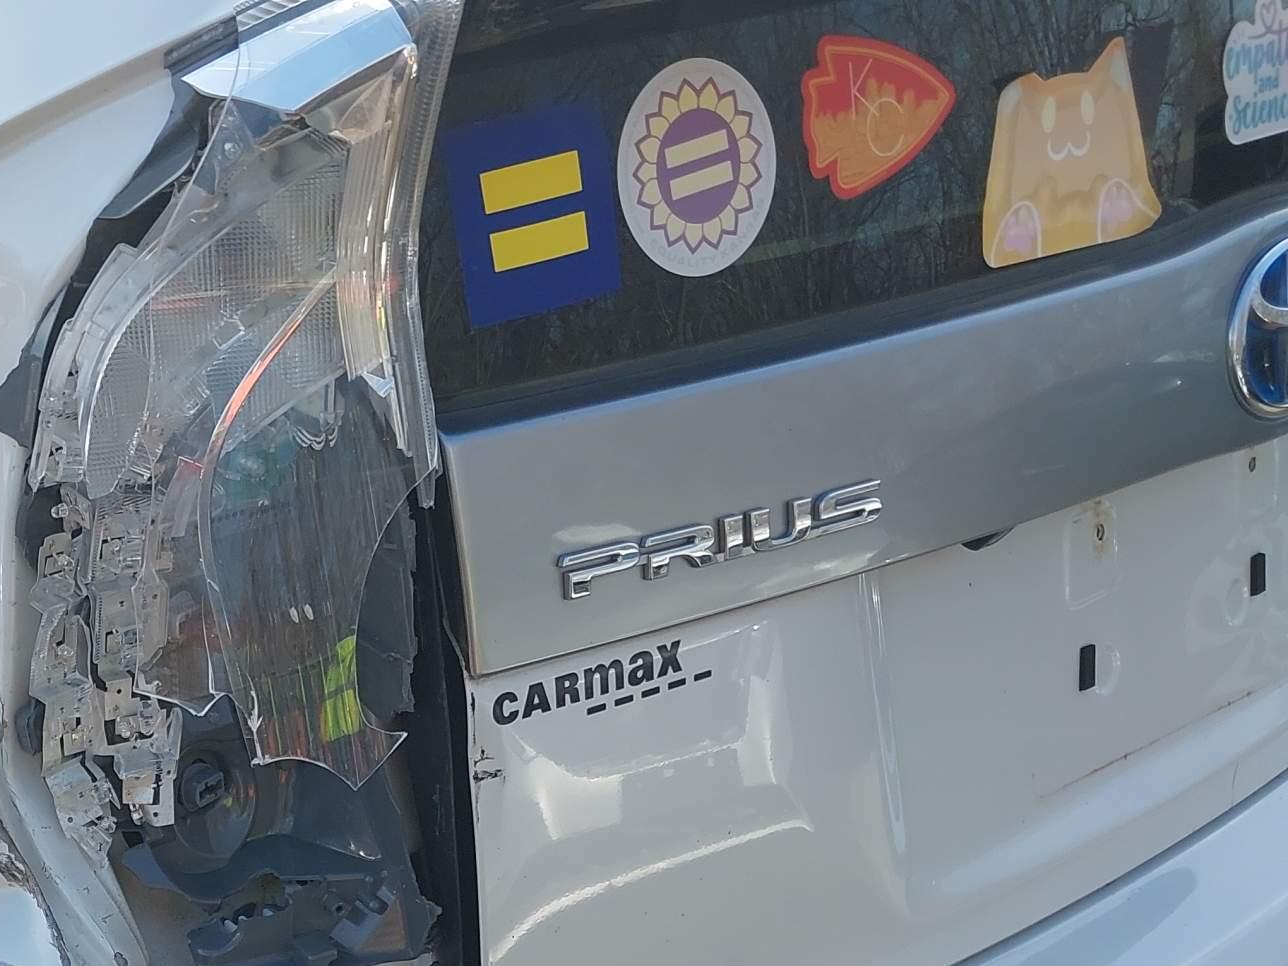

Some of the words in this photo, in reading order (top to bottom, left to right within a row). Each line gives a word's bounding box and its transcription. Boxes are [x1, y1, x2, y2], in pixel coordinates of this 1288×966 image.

[848, 58, 906, 157] KC
[558, 479, 882, 600] PRIUS
[493, 640, 684, 726] CARmax
